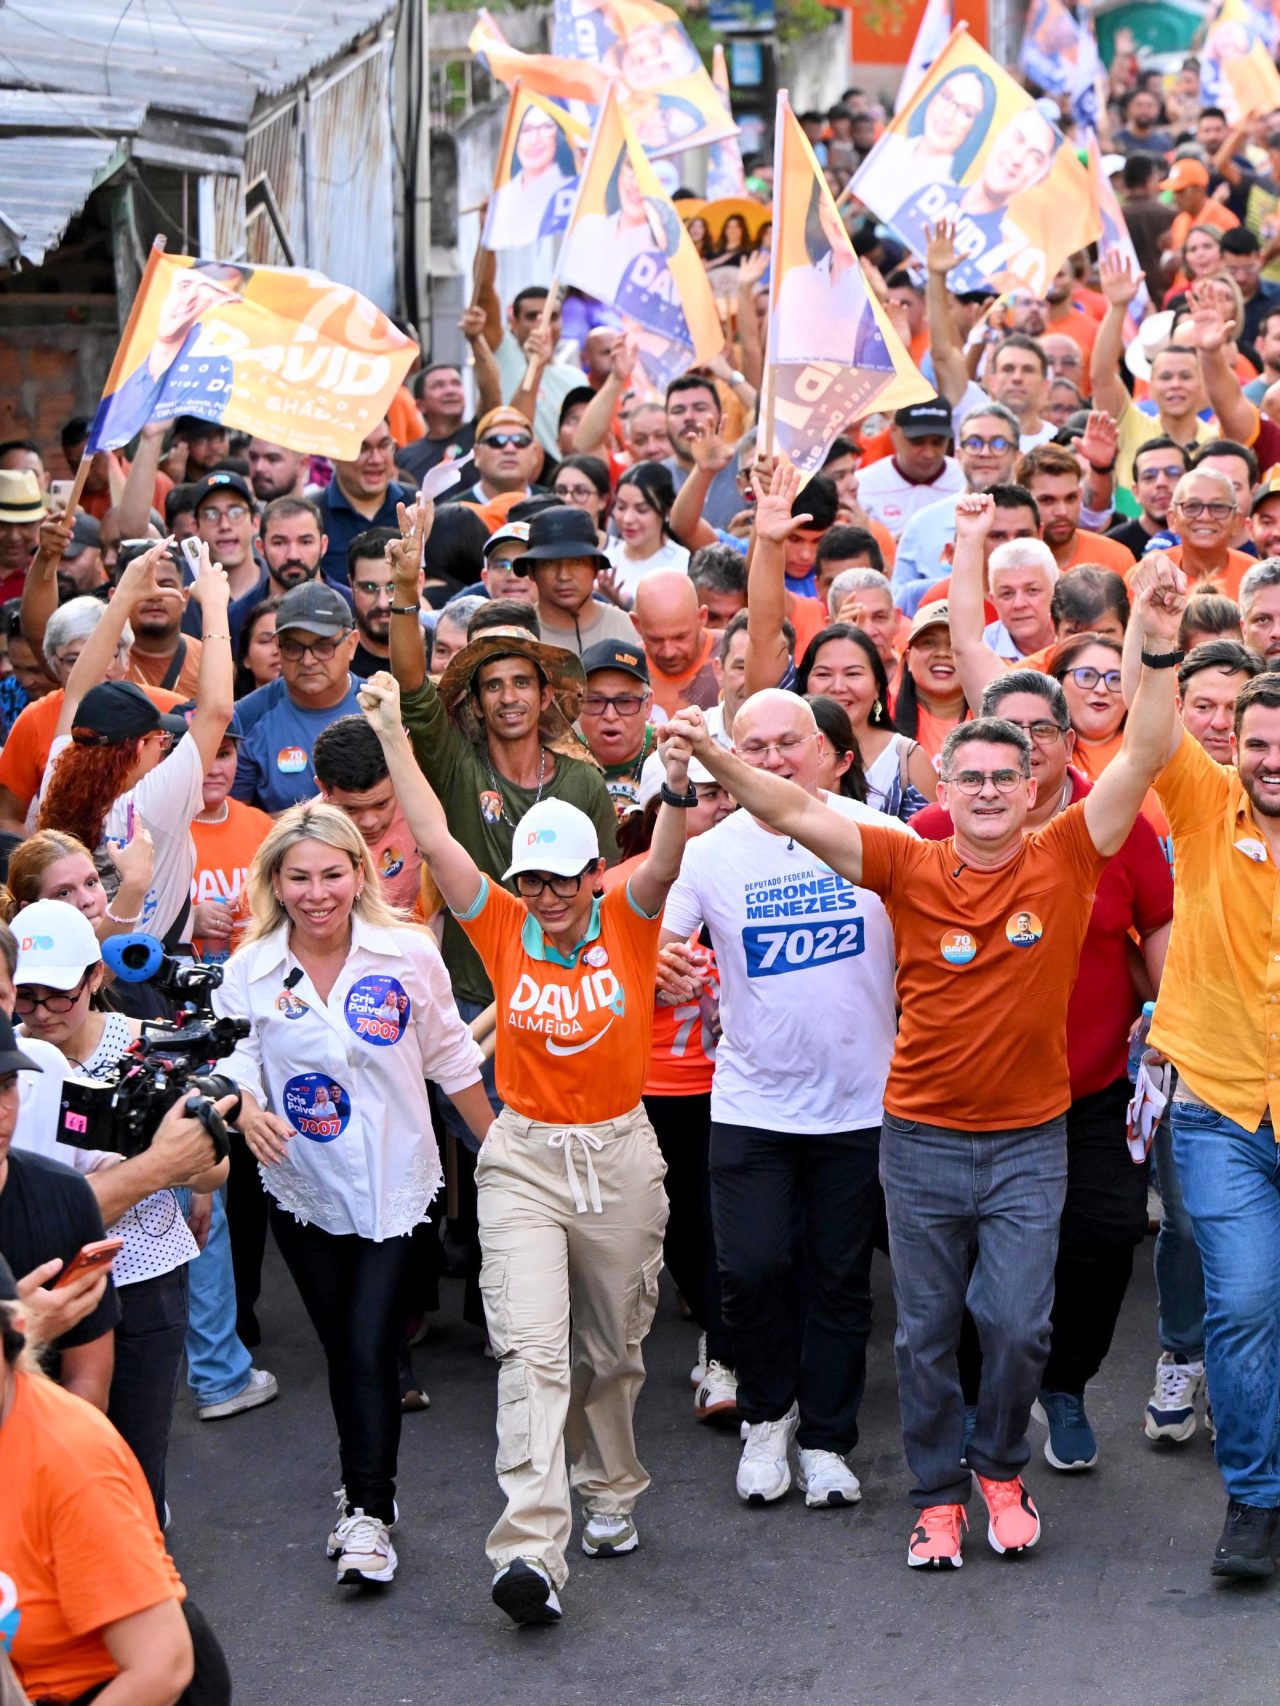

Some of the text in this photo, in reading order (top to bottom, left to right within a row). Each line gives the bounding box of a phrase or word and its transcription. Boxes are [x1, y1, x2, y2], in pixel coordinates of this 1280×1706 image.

[187, 319, 392, 396] DAVID
[527, 829, 557, 846] D70
[745, 870, 816, 891] DEPUTADO FEDERAL
[745, 875, 854, 905] CORONEL
[746, 891, 857, 919] MENEZES
[22, 935, 54, 951] D70
[757, 923, 858, 969] 7022
[953, 934, 972, 946] 70
[1024, 933, 1035, 941] 70
[944, 945, 972, 953] DAVID
[350, 993, 375, 1005] Cris
[509, 968, 620, 1021] DAVID
[348, 1002, 382, 1015] Paiva
[357, 1017, 399, 1043] 7007
[508, 1012, 584, 1036] ALMEIDA
[286, 1092, 307, 1106] Cris
[287, 1102, 316, 1116] Paiva
[298, 1117, 341, 1136] 7007
